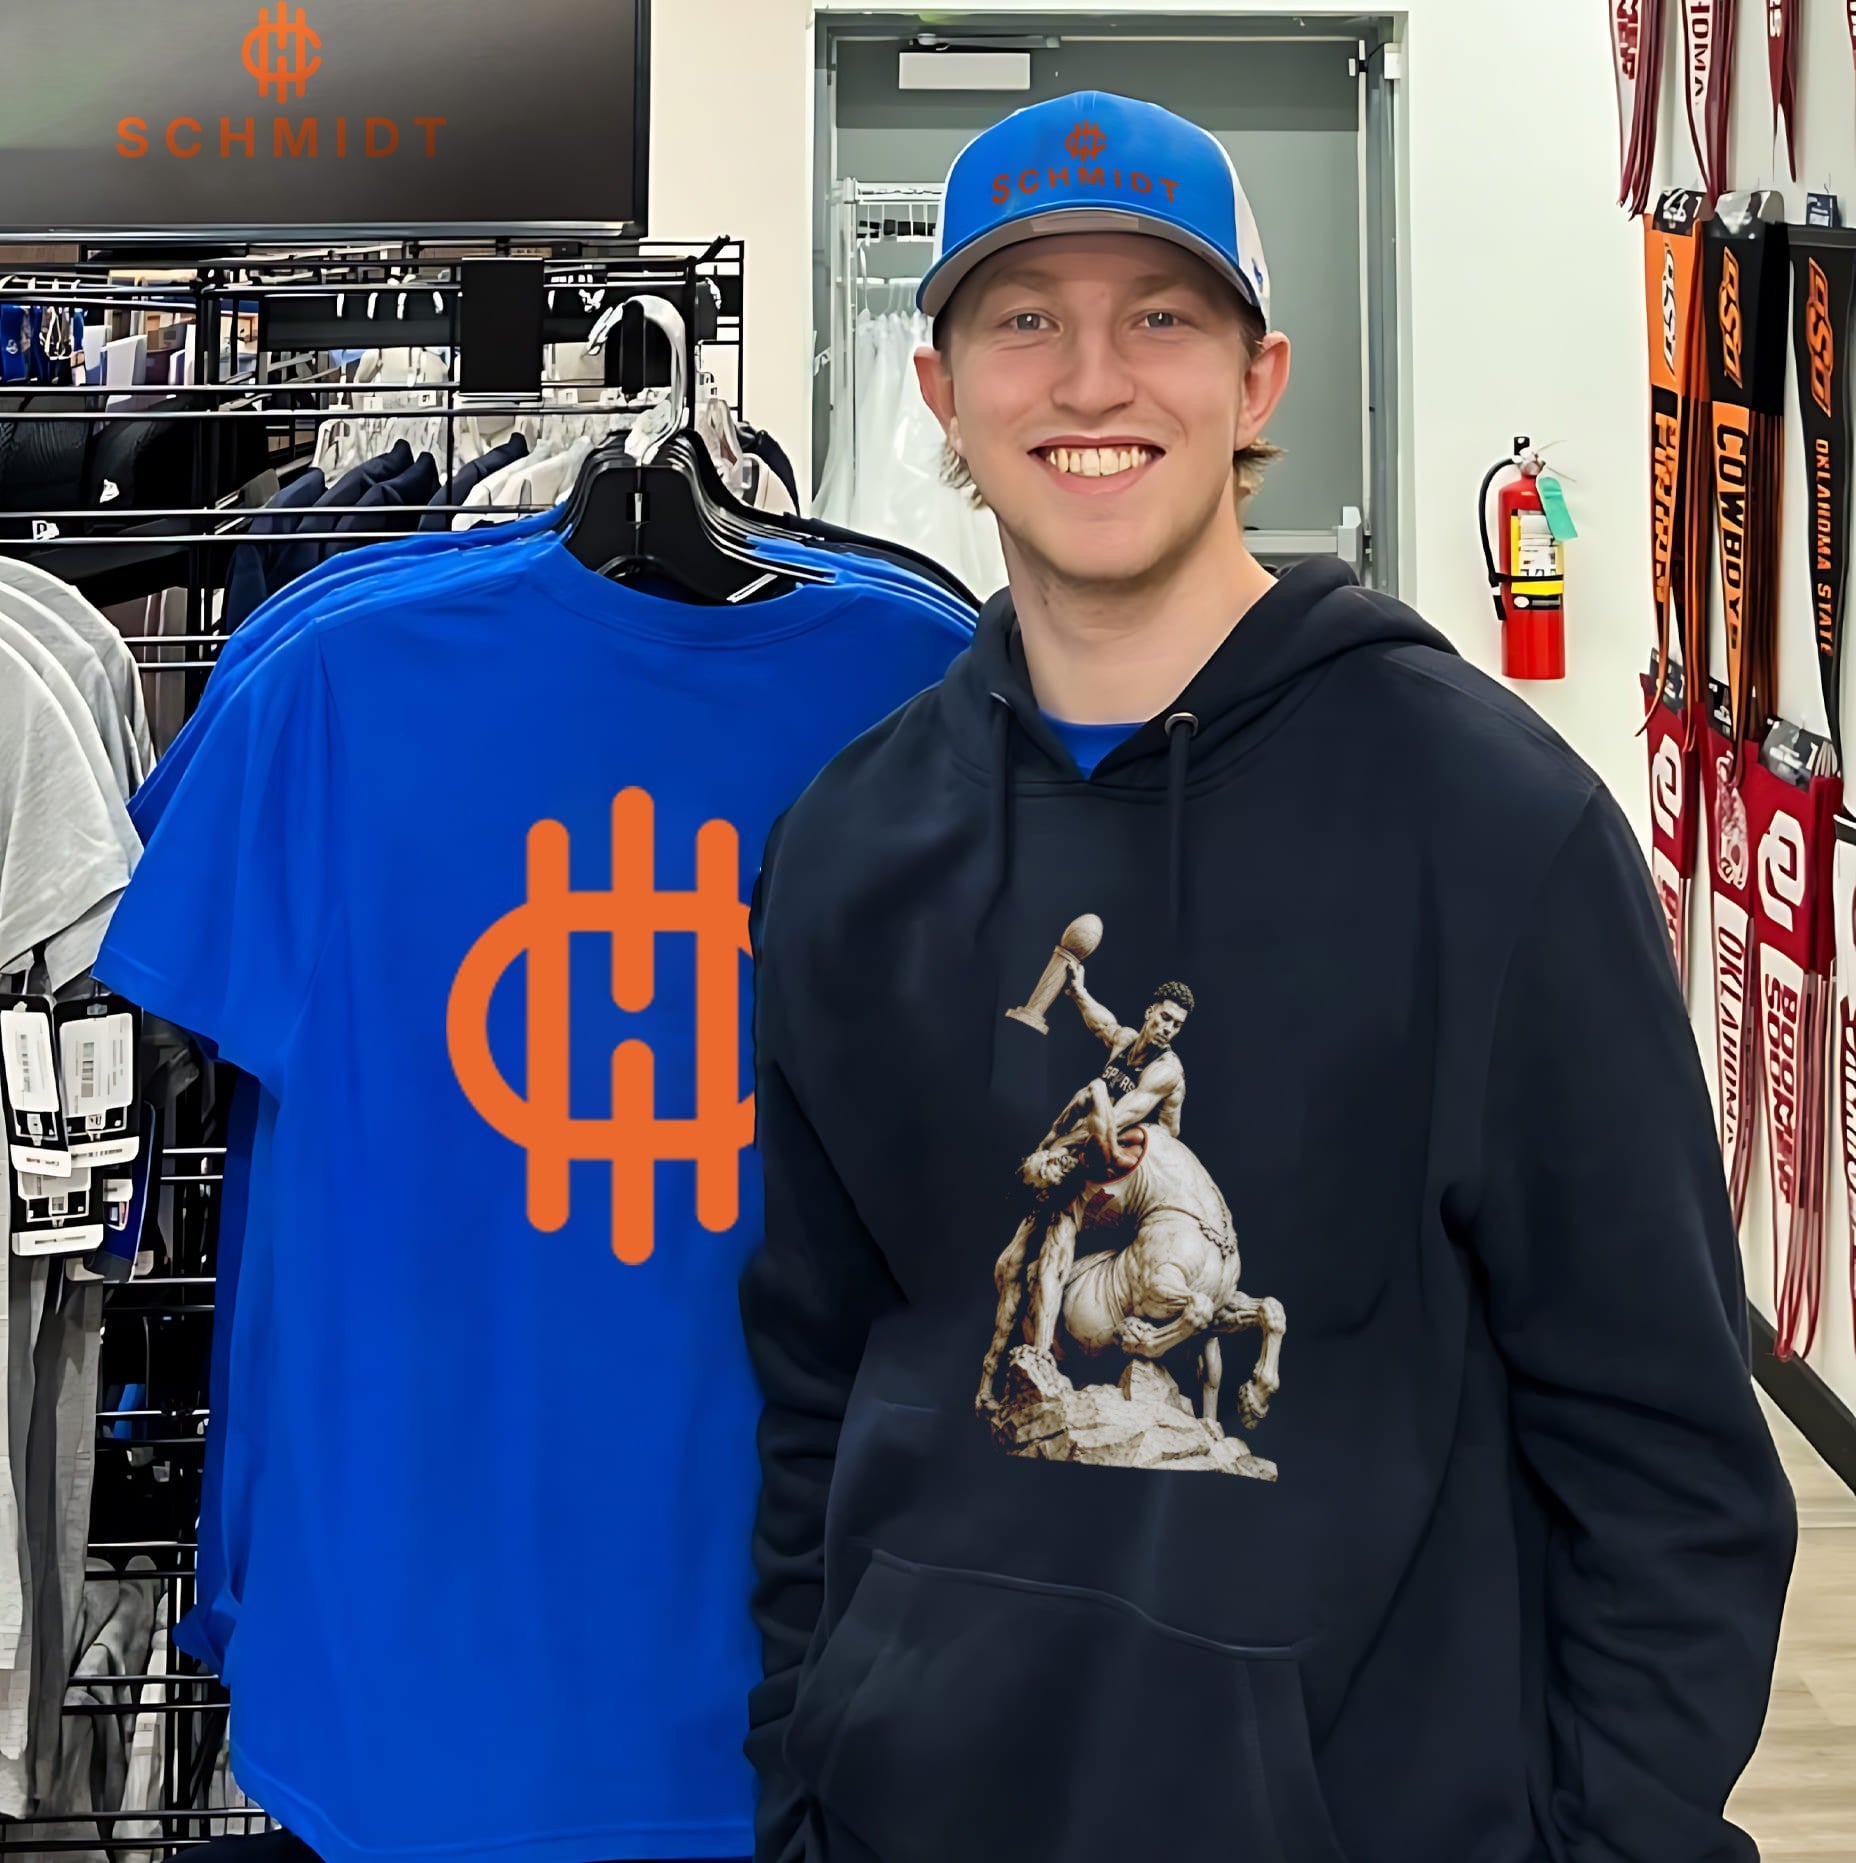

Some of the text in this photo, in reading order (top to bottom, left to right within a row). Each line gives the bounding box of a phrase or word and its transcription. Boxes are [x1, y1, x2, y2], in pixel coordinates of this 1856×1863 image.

[116, 116, 447, 158] SCHMIDT
[991, 167, 1179, 204] SCHMIDT
[1815, 438, 1833, 657] OKLAHOMA STATE
[1718, 925, 1746, 1146] OKLAHOMA
